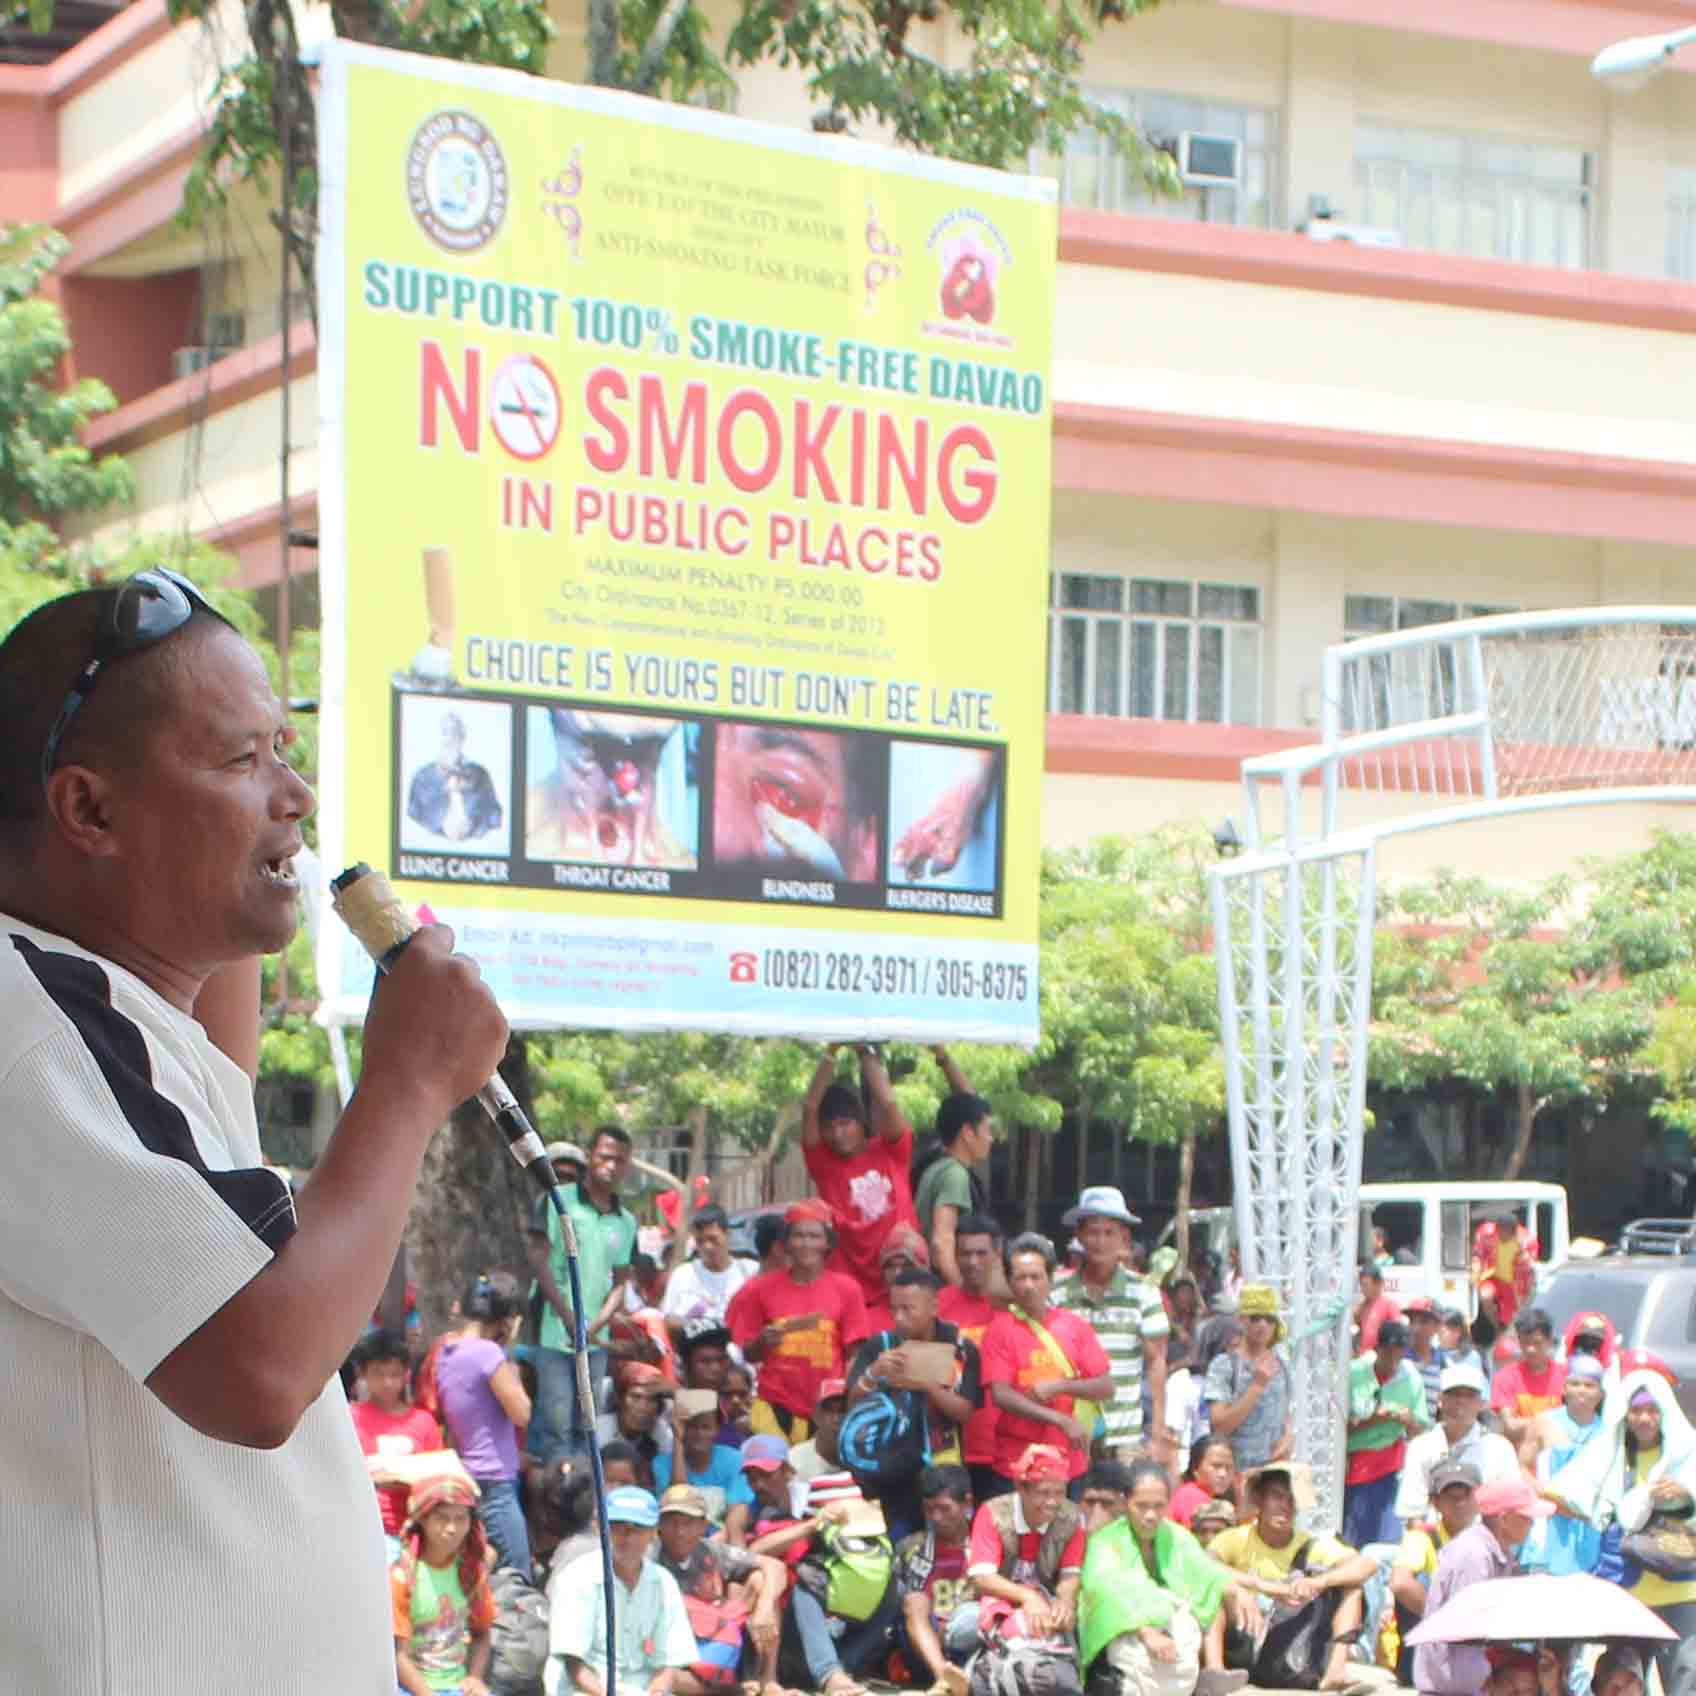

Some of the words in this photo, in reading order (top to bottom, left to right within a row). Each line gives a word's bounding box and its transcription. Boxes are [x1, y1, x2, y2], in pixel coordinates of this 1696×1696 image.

[365, 261, 560, 336] SUPPORT
[571, 298, 680, 356] 100%
[690, 315, 919, 394] SMOKE-FREE
[929, 358, 1044, 415] DAVAO
[584, 368, 998, 525] SMOKING
[501, 477, 553, 533] IN
[576, 488, 750, 556] PUBLIC
[770, 519, 943, 581] PLACES
[585, 555, 683, 586] MAXIMUM
[687, 565, 768, 594] PENALTY
[465, 636, 575, 692] CHOICE
[584, 650, 612, 694] IS
[623, 652, 720, 704] YOURS
[729, 665, 784, 710] BUT
[794, 671, 875, 717] DON'T
[887, 682, 921, 723] BE
[400, 856, 444, 878] LUNG
[446, 858, 510, 882] CANCER
[553, 864, 610, 888] THROAT
[612, 867, 670, 893] CANCER
[761, 877, 835, 902] BLINDNESS
[949, 892, 995, 915] DISEASE
[764, 950, 821, 993] (082)
[824, 952, 917, 994] 282-3971
[936, 956, 1028, 1002] 305-8375
